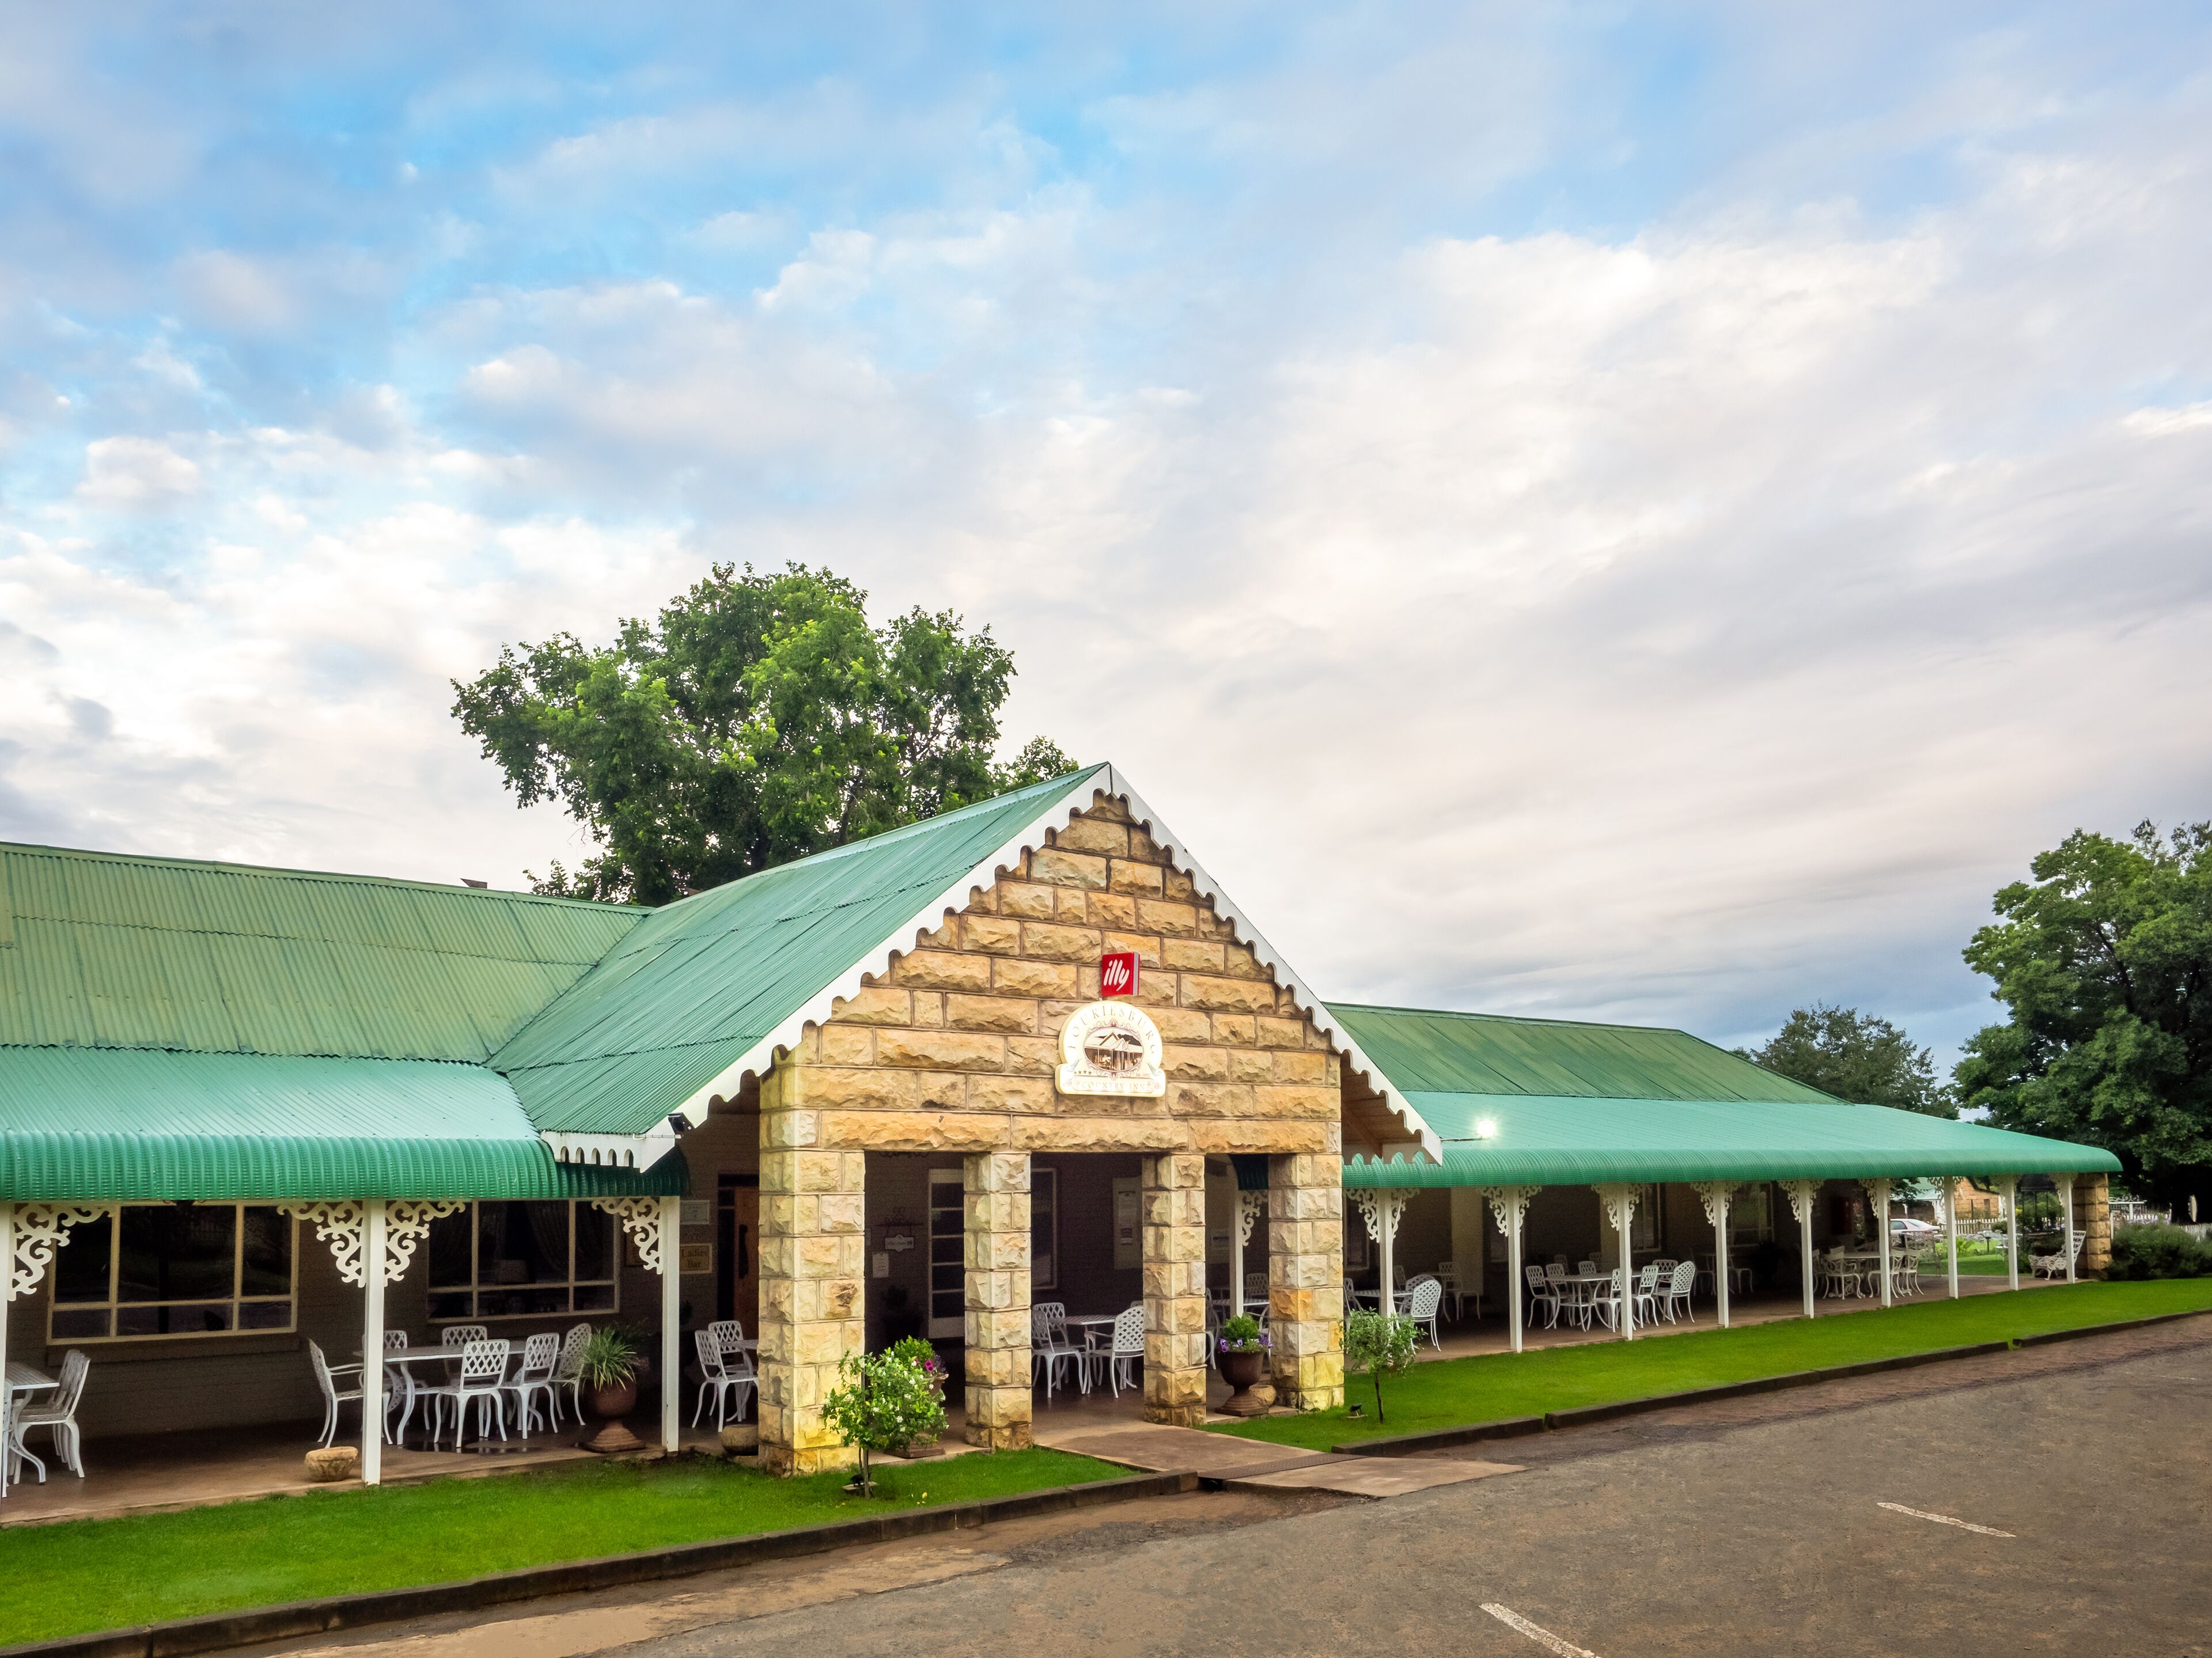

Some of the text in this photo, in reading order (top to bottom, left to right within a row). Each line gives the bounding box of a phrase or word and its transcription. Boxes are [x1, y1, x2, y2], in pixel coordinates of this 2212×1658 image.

[1103, 958, 1130, 991] illy
[1082, 1081, 1145, 1091] COUNTRY INN
[681, 1249, 708, 1257] Ladies
[688, 1259, 702, 1268] Bar
